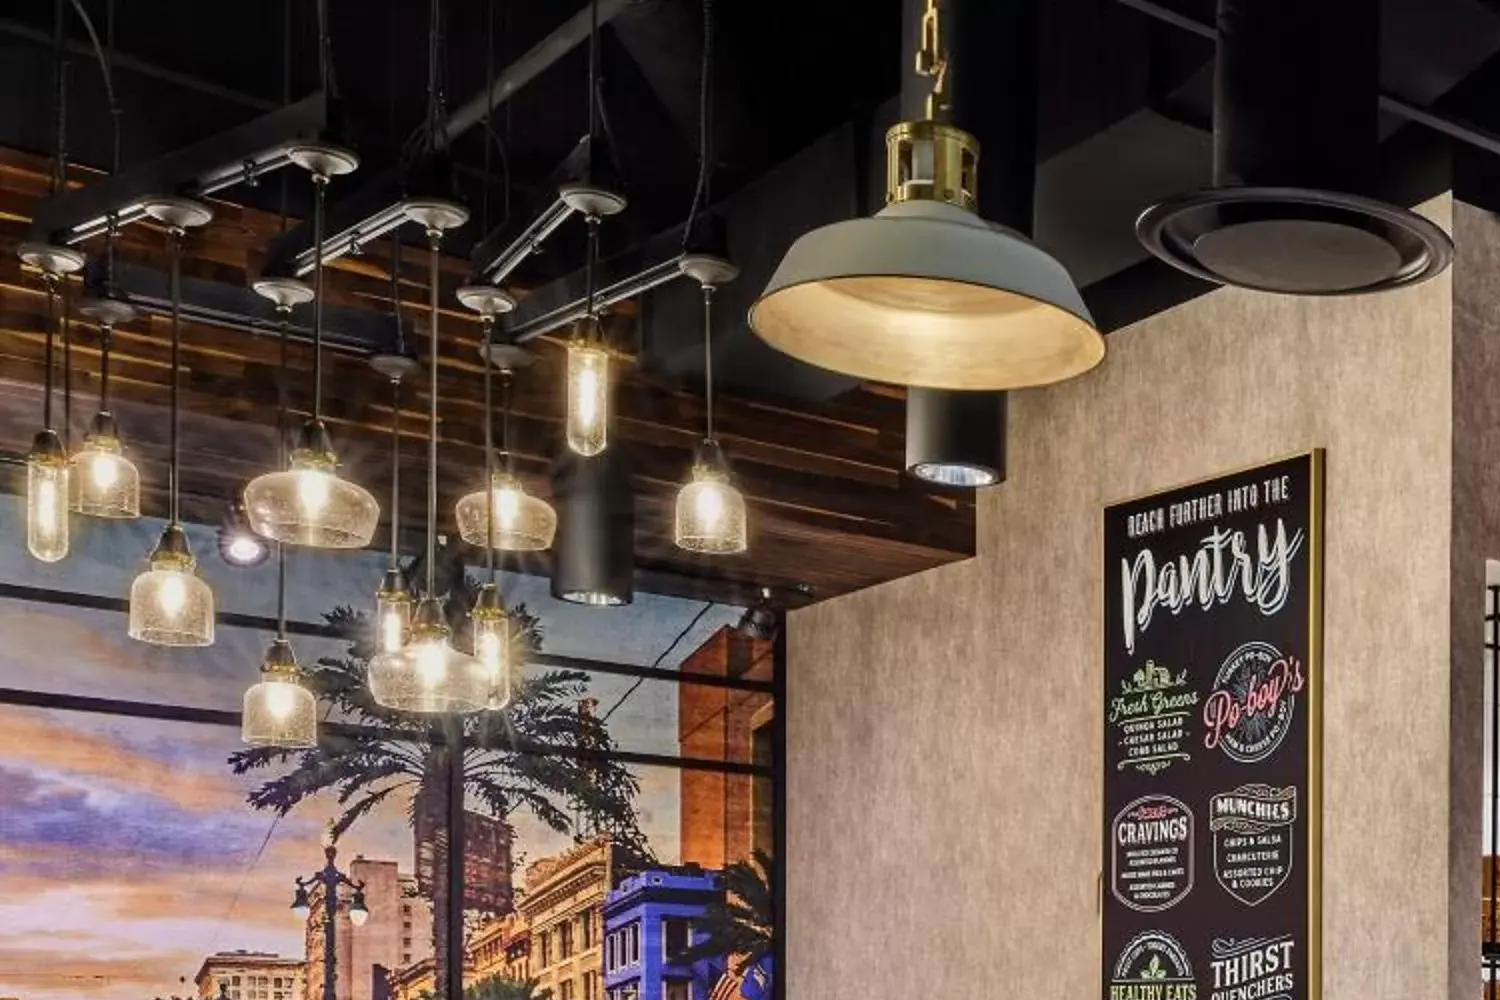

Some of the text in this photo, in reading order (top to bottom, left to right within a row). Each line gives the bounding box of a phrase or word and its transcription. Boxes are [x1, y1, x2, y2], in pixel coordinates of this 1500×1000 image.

[1127, 475, 1290, 538] REACH FURTHER INTO THE
[1121, 517, 1305, 656] Pantry
[1109, 691, 1200, 723] Fresh Greens
[1216, 797, 1290, 820] MUNCHIES
[1118, 815, 1188, 847] CRAVINGS
[1210, 941, 1295, 989] THIRST
